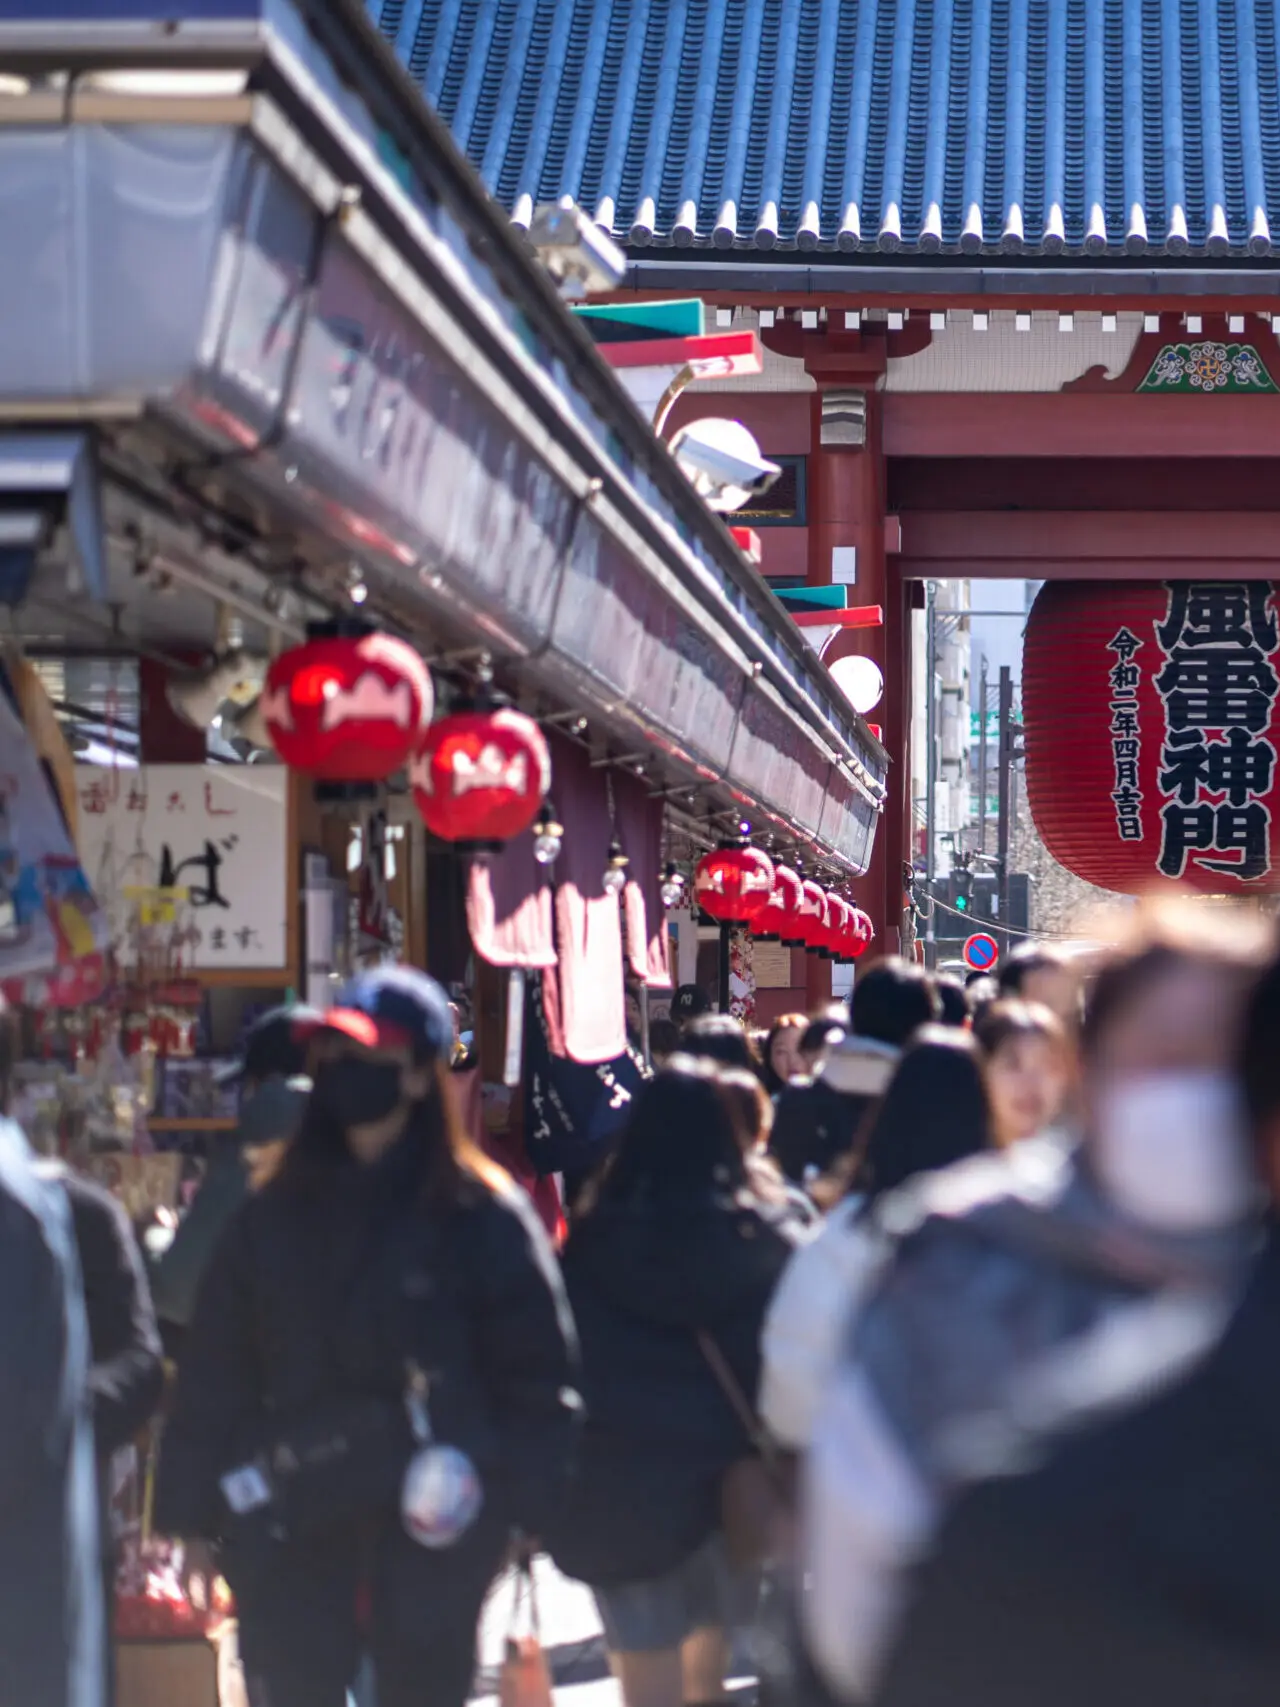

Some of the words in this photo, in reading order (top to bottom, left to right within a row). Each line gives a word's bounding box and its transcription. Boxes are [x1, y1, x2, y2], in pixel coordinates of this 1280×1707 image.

[1107, 627, 1144, 841] 令和二年四月吉日
